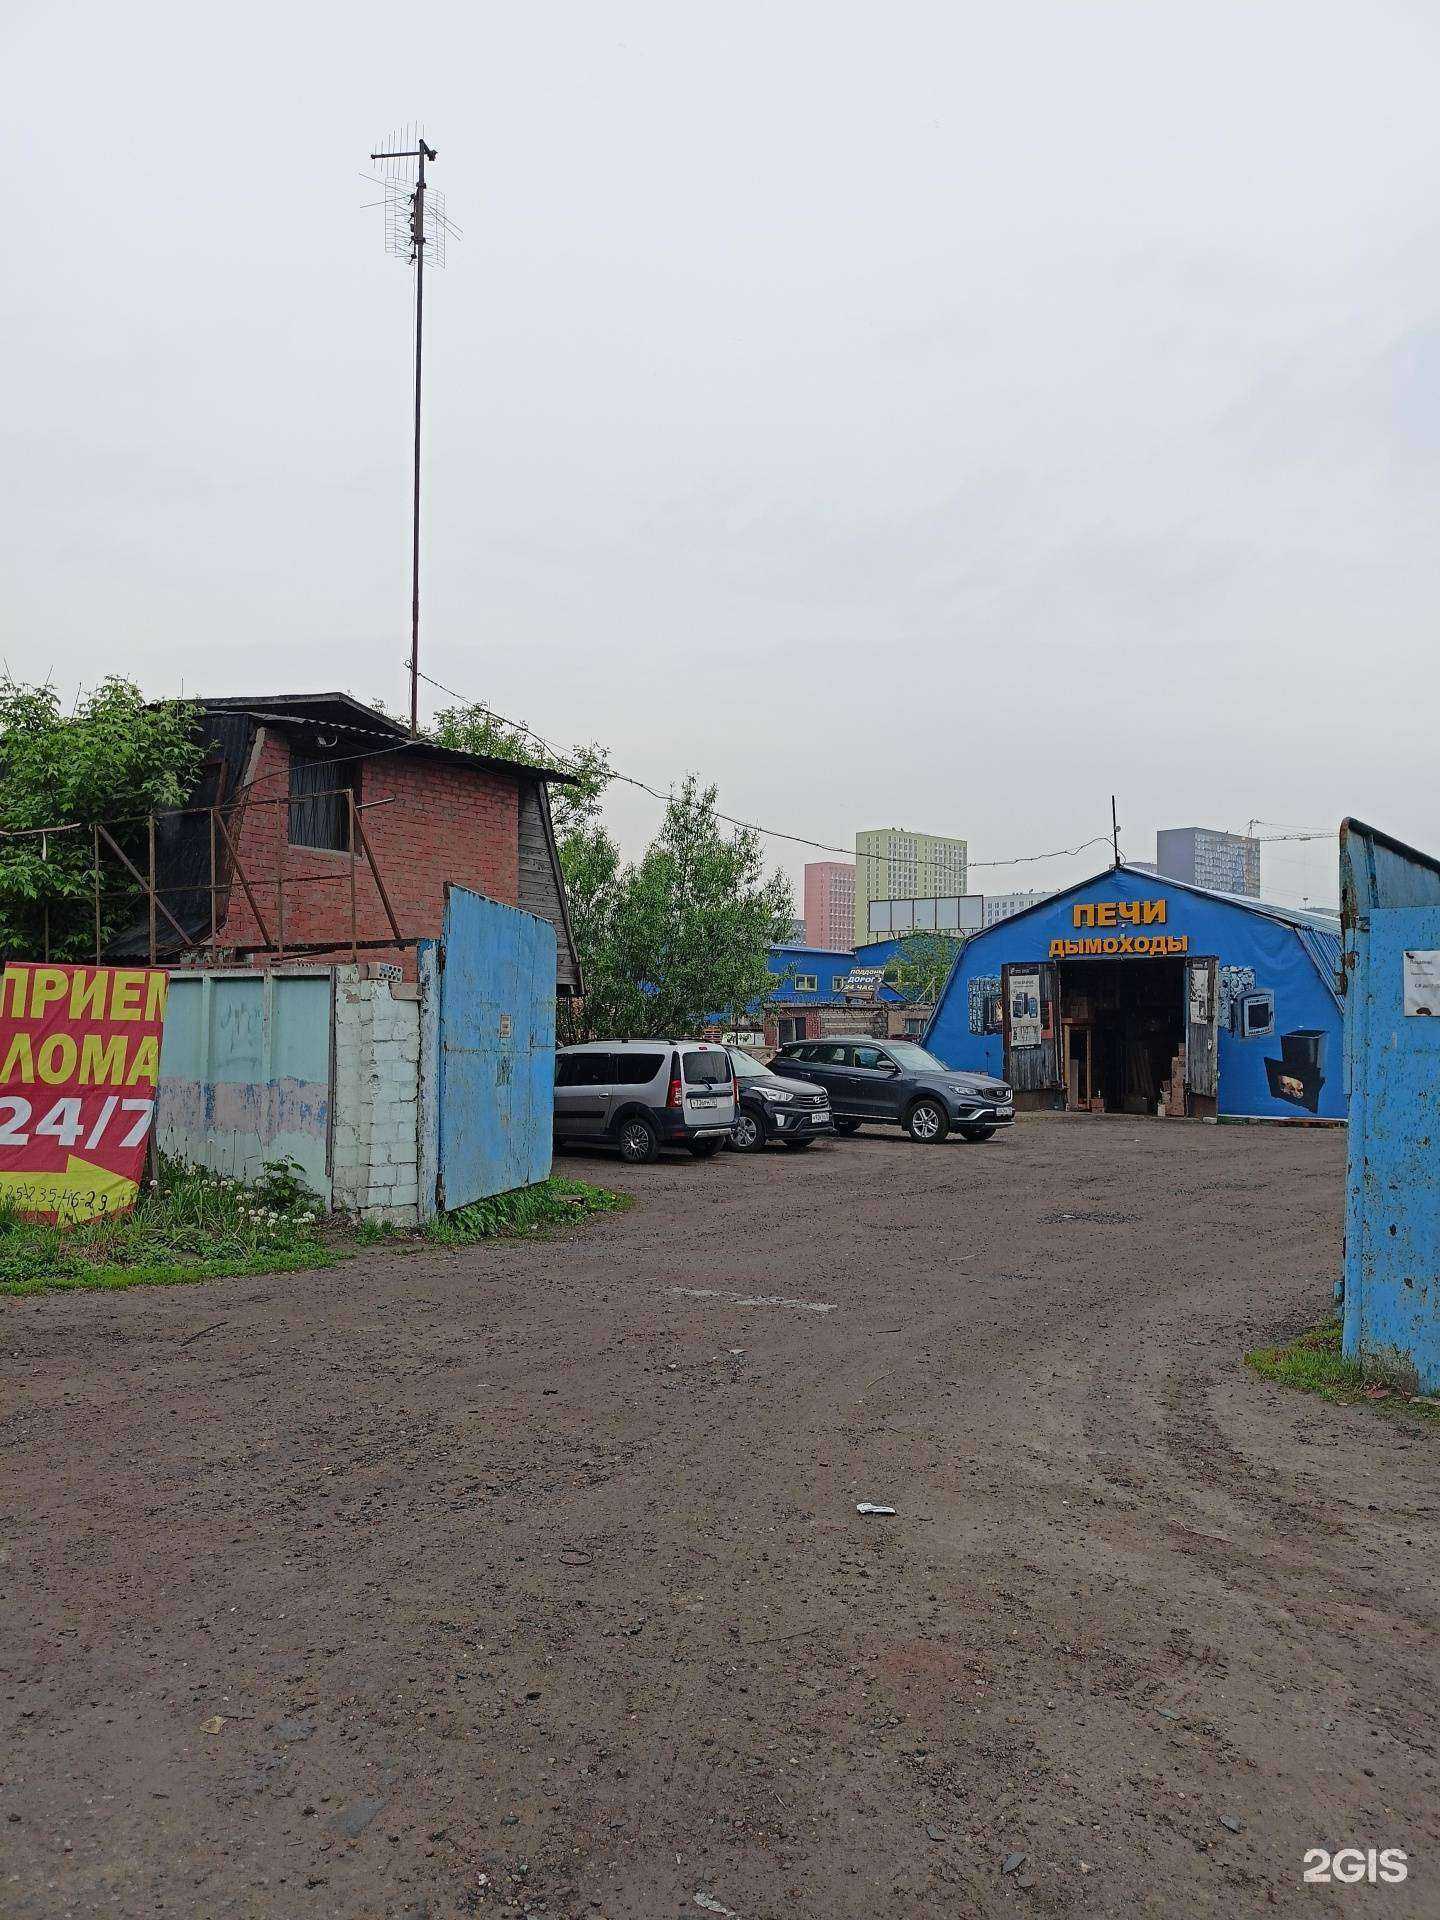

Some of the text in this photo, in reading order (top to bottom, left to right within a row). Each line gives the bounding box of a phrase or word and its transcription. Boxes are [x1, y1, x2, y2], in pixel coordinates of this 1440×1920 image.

[1073, 900, 1166, 928] ПЕЧИ
[1049, 935, 1188, 958] ДЫМОХОДЫ
[0, 1033, 158, 1086] ЛОМА
[0, 1096, 155, 1149] 24/7
